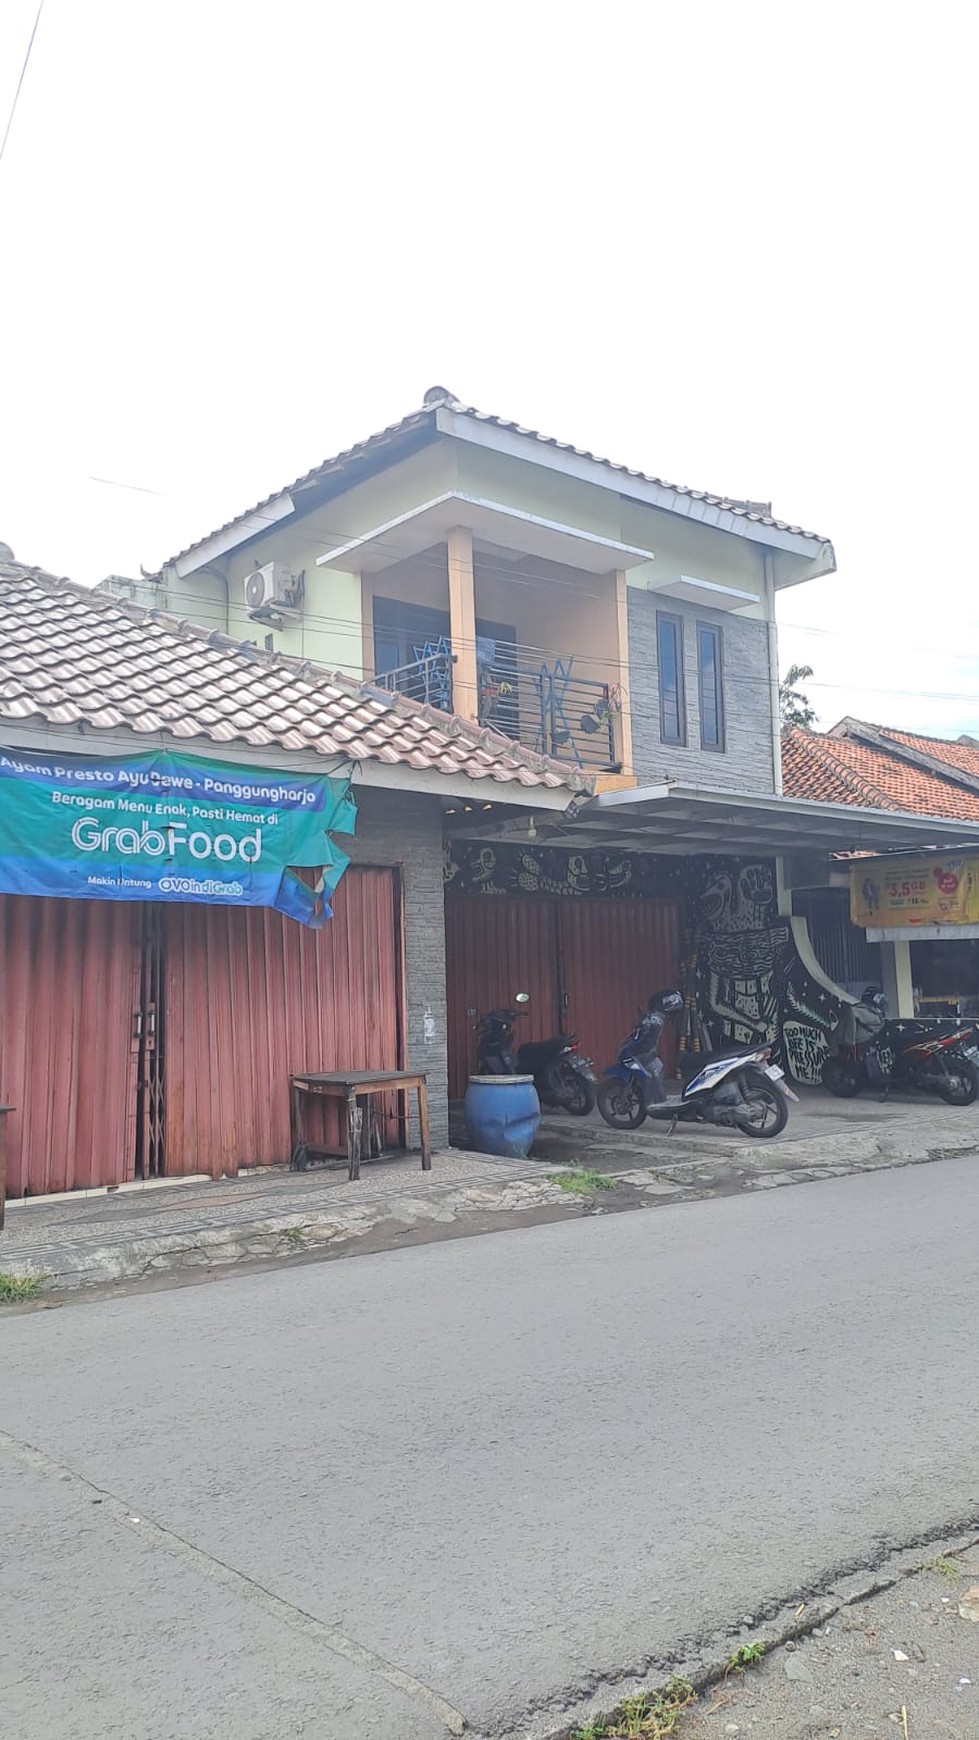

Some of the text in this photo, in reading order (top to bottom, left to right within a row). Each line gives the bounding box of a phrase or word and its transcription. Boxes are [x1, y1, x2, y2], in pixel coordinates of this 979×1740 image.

[1, 756, 53, 776] Ayam
[54, 766, 115, 781] Presto
[118, 770, 149, 787] Ayu
[204, 778, 316, 804] Panggungharjo
[51, 791, 279, 825] Beragam Menu Enak, Pasti Hemat di
[71, 816, 262, 863] GrabFood
[87, 876, 116, 886] Makin
[117, 878, 152, 889] Untung
[784, 1026, 821, 1041] TOO MUCH
[805, 1039, 816, 1052] IS
